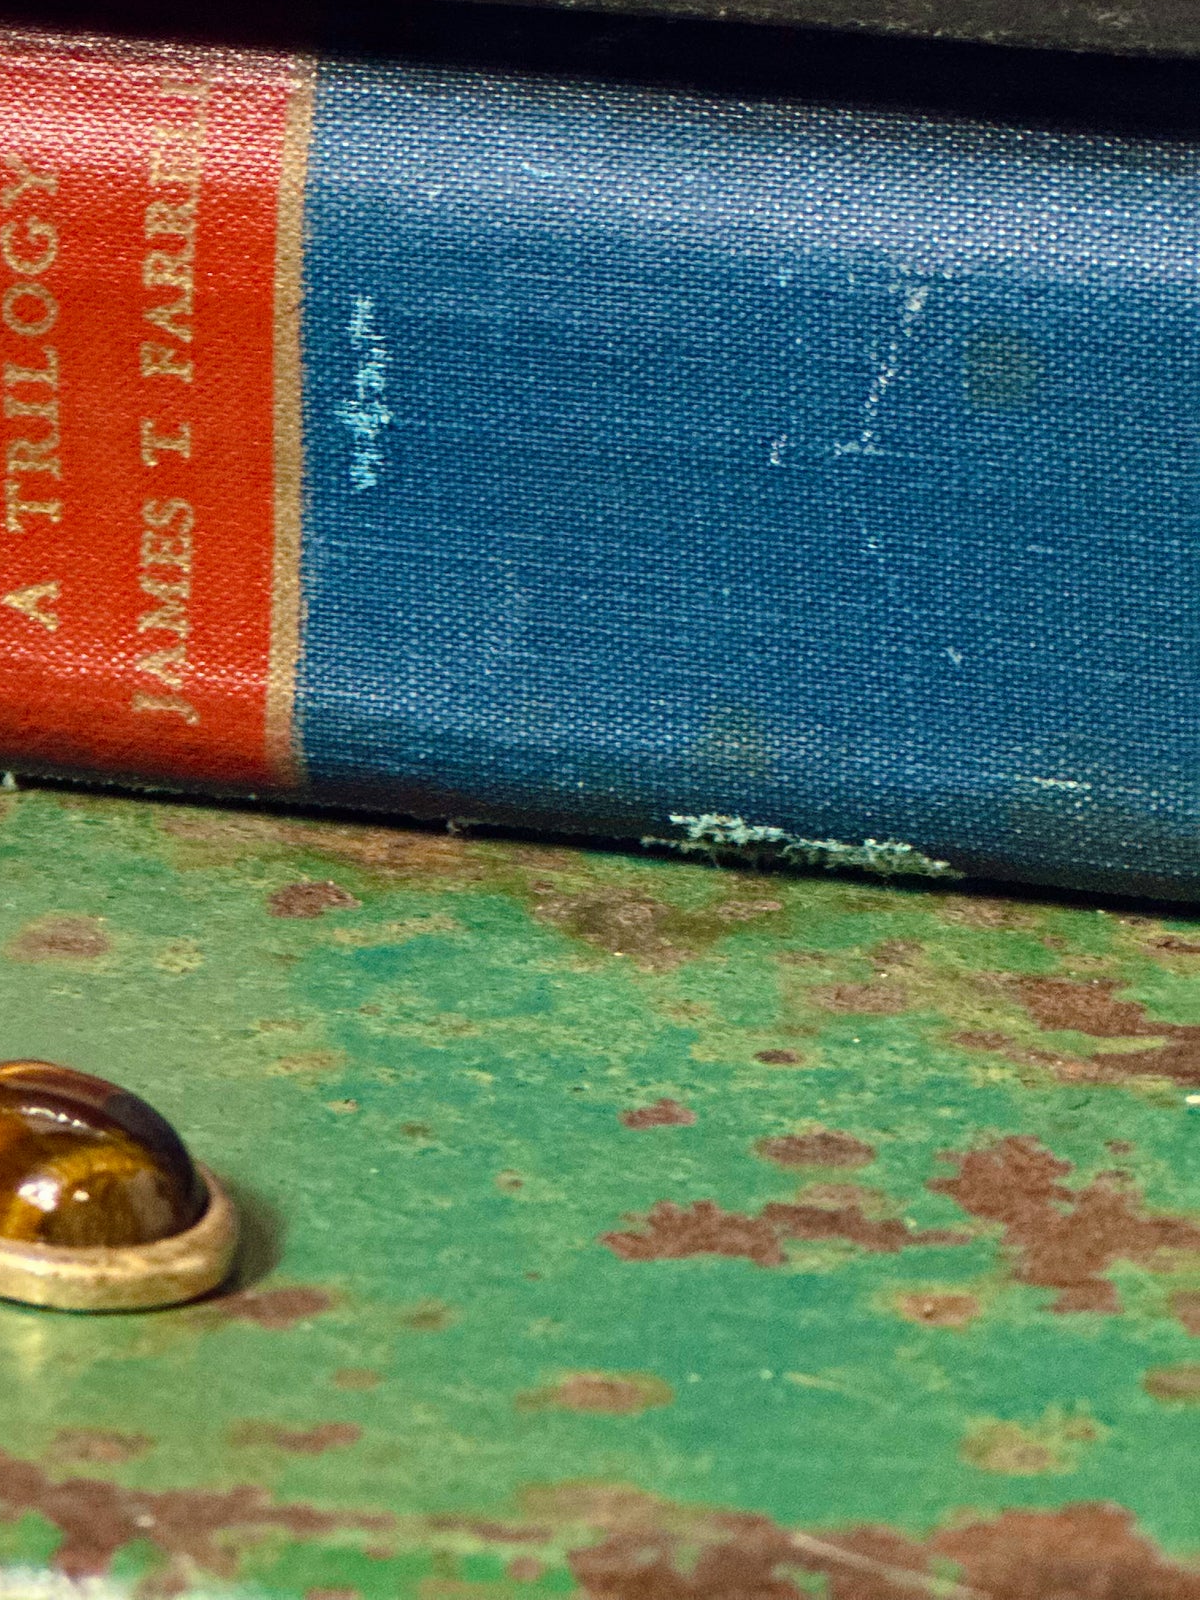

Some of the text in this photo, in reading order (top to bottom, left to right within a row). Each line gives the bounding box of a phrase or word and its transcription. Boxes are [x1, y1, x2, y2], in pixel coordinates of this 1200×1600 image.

[3, 152, 62, 632] A TRILOGY
[134, 499, 198, 724] JAMES
